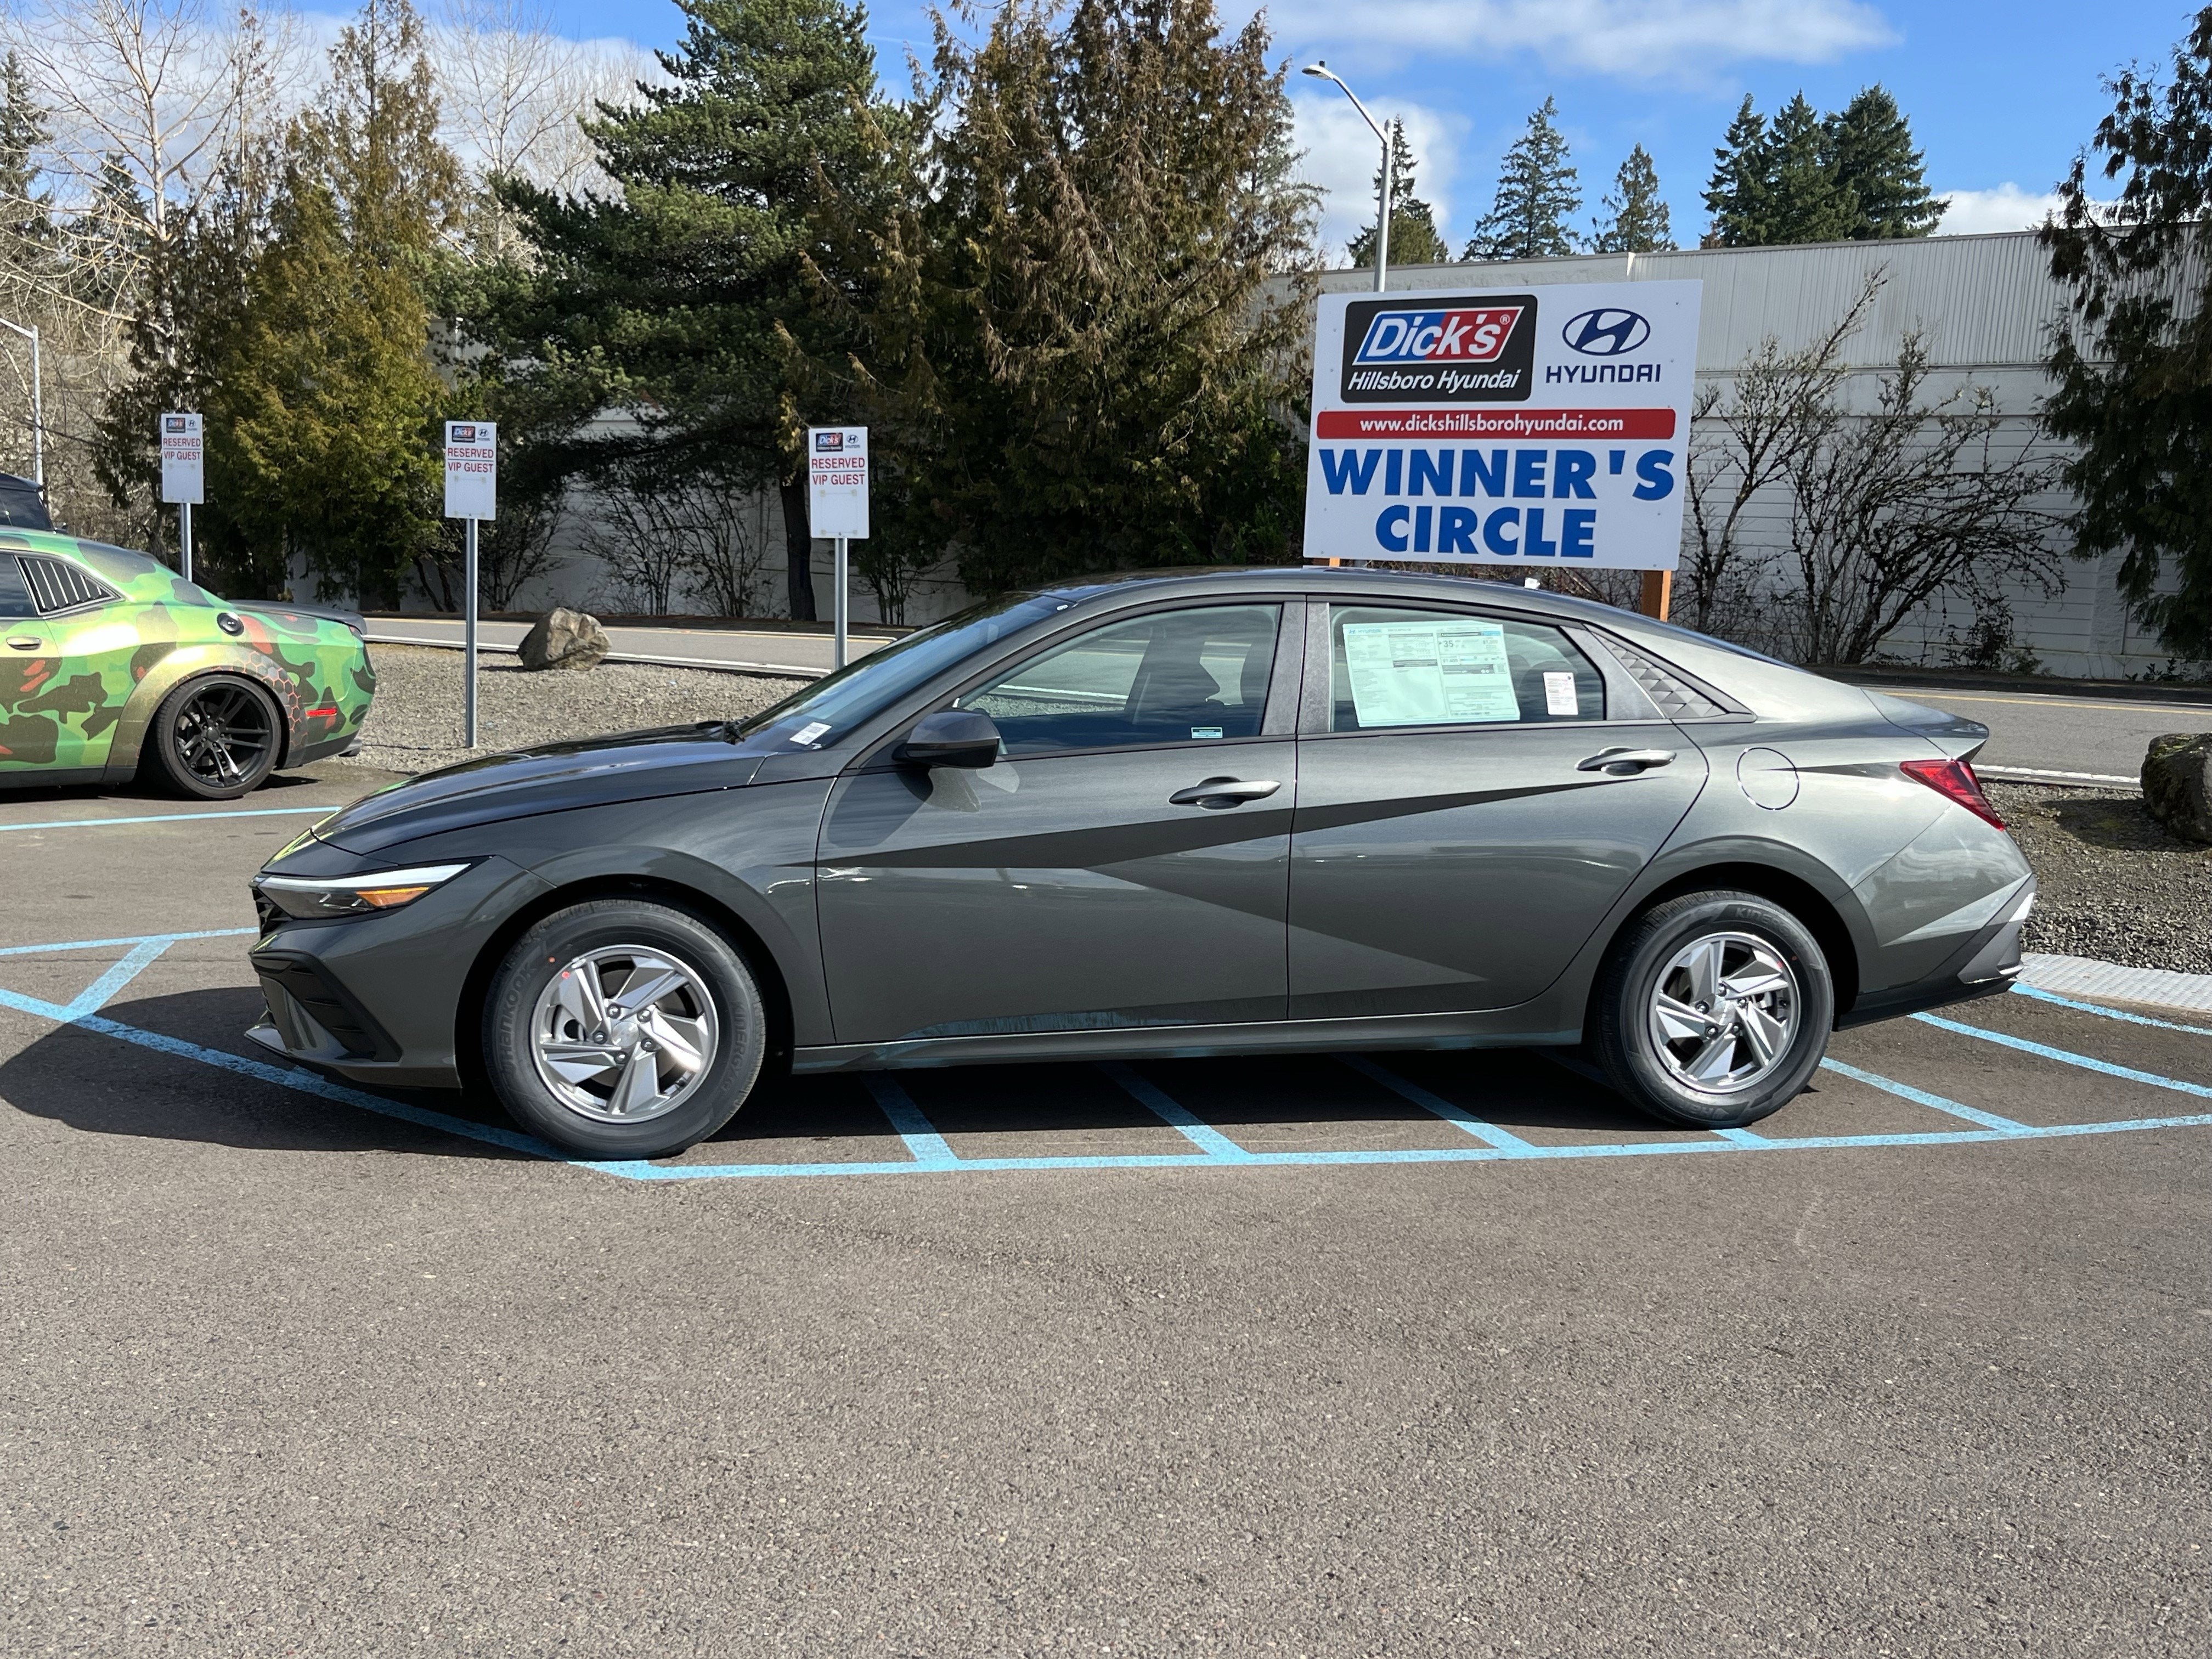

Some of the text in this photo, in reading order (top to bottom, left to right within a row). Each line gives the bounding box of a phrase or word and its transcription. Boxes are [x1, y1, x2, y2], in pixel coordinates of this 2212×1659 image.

[1366, 314, 1501, 357] Dick's
[1348, 369, 1521, 394] Hillsboro Hyundai
[1545, 364, 1661, 383] HYUNDAI
[1360, 413, 1624, 436] www.dickshillsborohyundai.com
[163, 438, 201, 447] RESERVED
[164, 451, 201, 460] VIP GUEST
[448, 447, 494, 459] RESERVED
[448, 461, 494, 473] VIP GUEST
[811, 457, 865, 469] RESERVED
[812, 473, 865, 486] VIP GUEST
[1318, 449, 1675, 502] WINNER'S
[1375, 504, 1596, 558] CIRCLE
